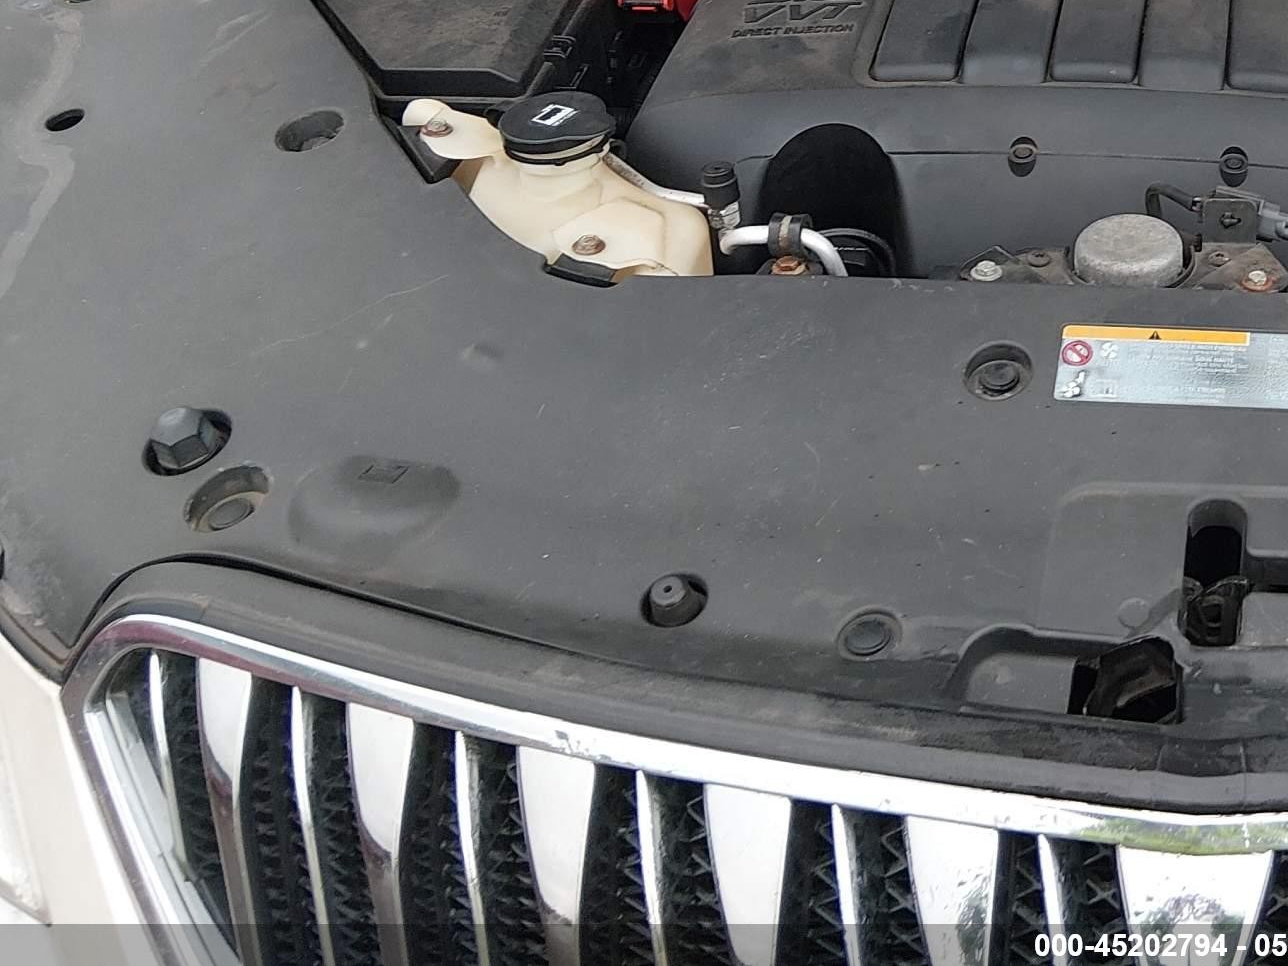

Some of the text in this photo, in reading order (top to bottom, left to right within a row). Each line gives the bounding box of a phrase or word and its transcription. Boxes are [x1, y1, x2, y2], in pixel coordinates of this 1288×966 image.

[743, 1, 862, 23] VVT
[730, 24, 855, 38] DIRECT INJECTION
